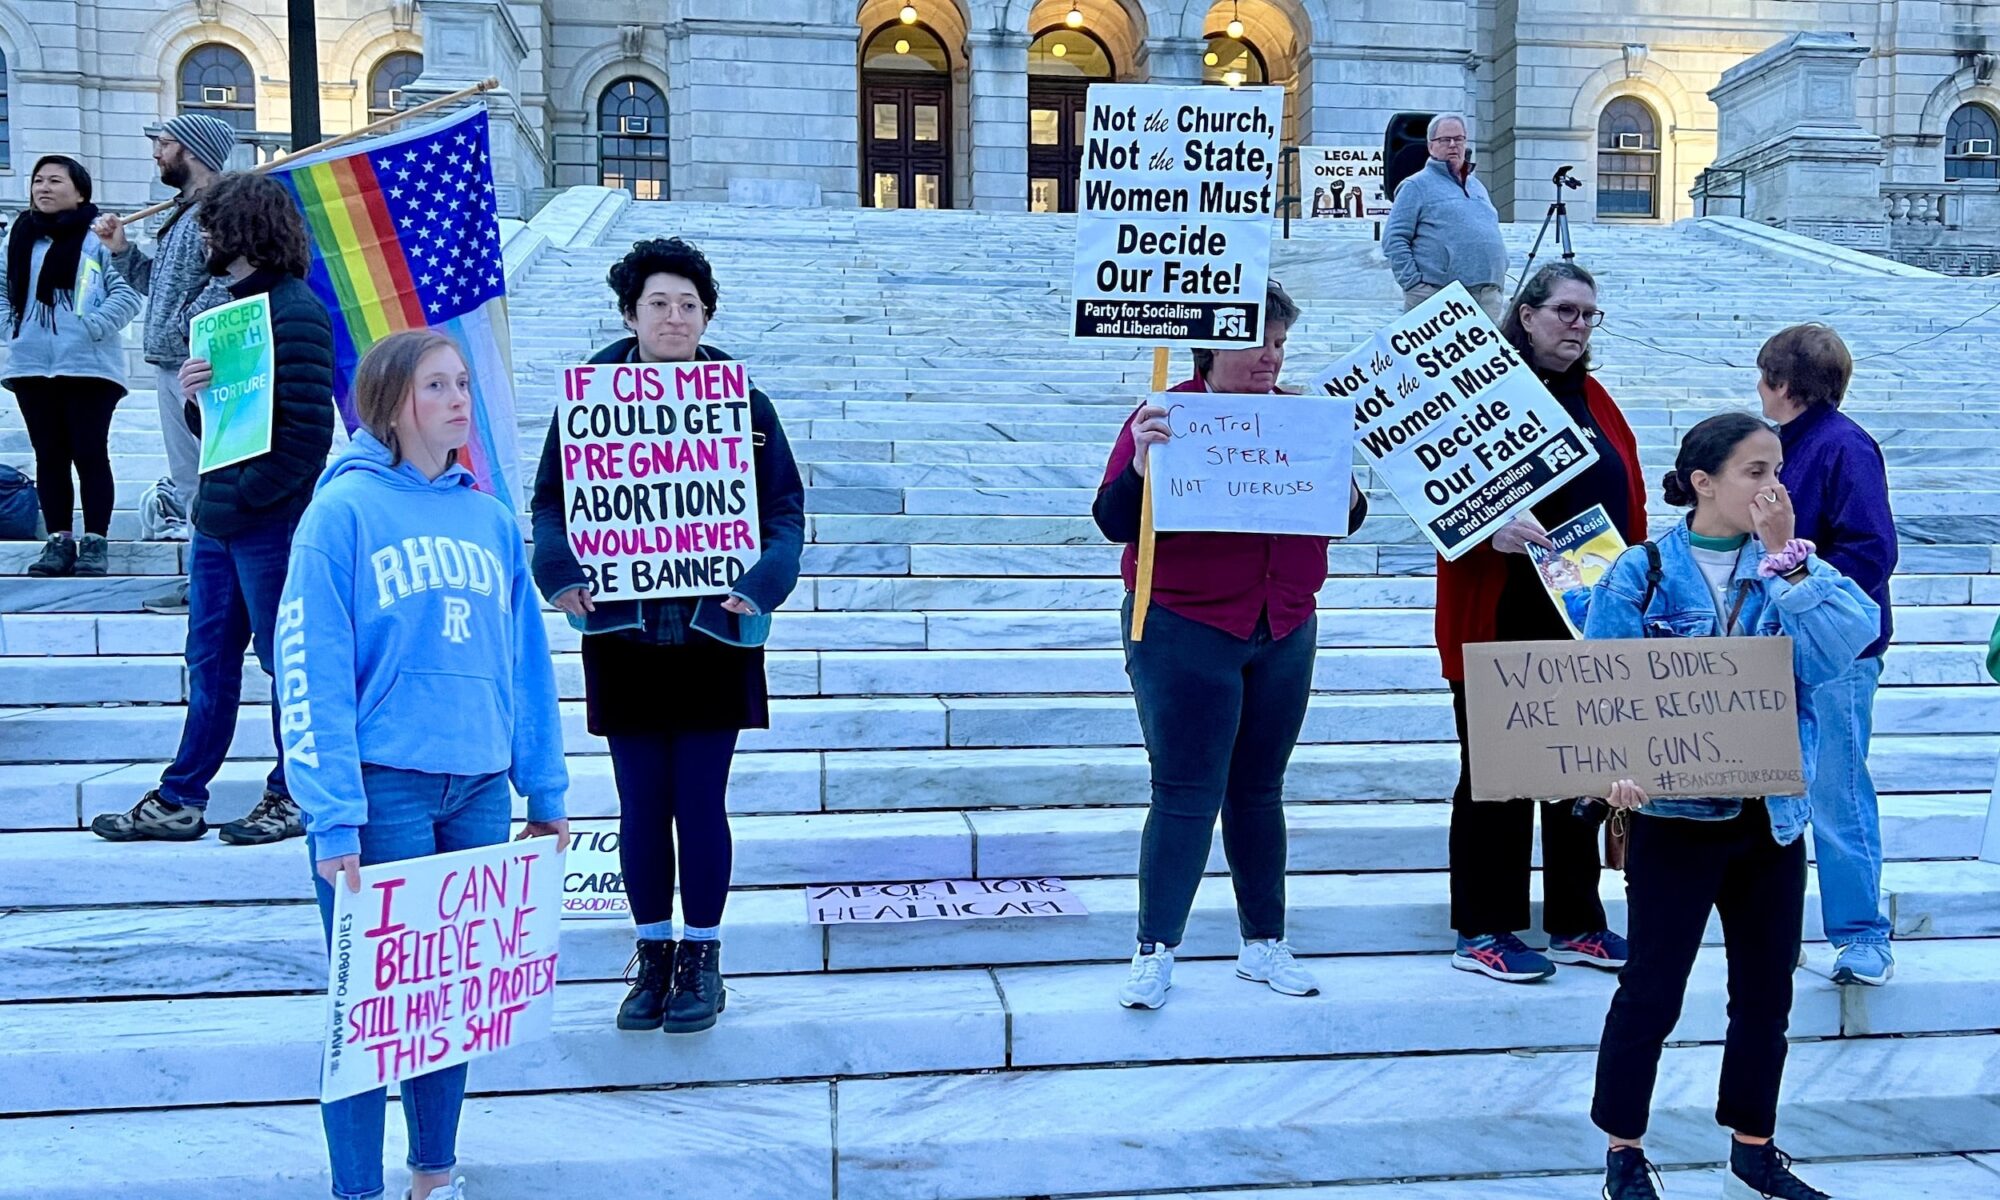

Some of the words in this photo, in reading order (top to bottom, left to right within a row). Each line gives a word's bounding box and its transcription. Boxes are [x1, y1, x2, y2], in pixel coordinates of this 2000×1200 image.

[1093, 104, 1136, 132] Not
[1143, 108, 1169, 132] the
[1177, 105, 1274, 140] Church,
[1088, 138, 1140, 170] Not
[1148, 147, 1174, 171] the
[1183, 139, 1273, 180] State,
[1314, 165, 1354, 176] ONCE
[1324, 150, 1368, 161] LEGAL
[1085, 180, 1188, 213] Women
[1200, 181, 1271, 214] Must
[1117, 224, 1227, 256] Decide
[1096, 260, 1153, 293] Our
[1162, 261, 1242, 295] Fate!
[196, 303, 263, 337] FORCED
[1084, 302, 1120, 319] Party
[1121, 303, 1140, 318] for
[1142, 304, 1202, 320] Socialism
[1095, 320, 1121, 335] and
[1123, 321, 1188, 336] Liberation
[1212, 315, 1250, 338] PSL
[207, 326, 263, 350] BIRTH
[1323, 364, 1369, 397] Not
[1370, 350, 1394, 376] the
[1390, 299, 1477, 356] Church,
[211, 373, 267, 404] TORTURE
[564, 366, 596, 402] IF
[612, 366, 665, 403] CIS
[675, 363, 745, 401] MEN
[1354, 384, 1395, 431] Not
[1397, 373, 1420, 399] the
[1415, 326, 1499, 378] State,
[567, 403, 677, 440] COULD
[684, 401, 748, 435] GET
[1360, 390, 1457, 460] Women
[1451, 345, 1520, 399] Must
[1206, 445, 1290, 467] SPERM
[1413, 399, 1511, 472] Decide
[564, 436, 749, 481] PREGNANT,
[1423, 464, 1476, 507] Our
[1472, 409, 1548, 472] Fate!
[1546, 441, 1582, 474] PSL
[569, 479, 746, 525] ABORTIONS
[1171, 478, 1211, 497] NOT
[1228, 480, 1314, 497] UTERUSES
[1436, 505, 1469, 531] Party
[1465, 493, 1484, 515] for
[1484, 460, 1534, 501] Socialism
[1457, 517, 1481, 537] and
[1478, 479, 1534, 527] Liberation
[570, 525, 673, 559] WOULD
[675, 519, 755, 553] NEVER
[370, 535, 509, 615] RHODY
[580, 562, 619, 597] BE
[631, 555, 745, 593] BANNED
[278, 596, 320, 768] RUGBY
[1493, 652, 1631, 690] WOMENS
[1648, 649, 1738, 680] BODIES
[1505, 700, 1560, 730] ARE
[1577, 697, 1649, 726] MORE
[1655, 688, 1787, 719] REGULATED
[1546, 744, 1628, 774] THAN
[1648, 731, 1744, 768] GUNS...
[364, 878, 406, 939] I
[438, 854, 540, 921] CAN'T
[812, 877, 1067, 900] ABORTIONS
[374, 919, 487, 992] BELIEVE
[493, 906, 538, 962] WE
[346, 995, 400, 1044] STILL
[406, 982, 454, 1034] HAVE
[459, 975, 482, 1017] TO
[488, 953, 558, 1010] PROTEST
[364, 1025, 451, 1083] THIS
[462, 1000, 532, 1052] SHIT
